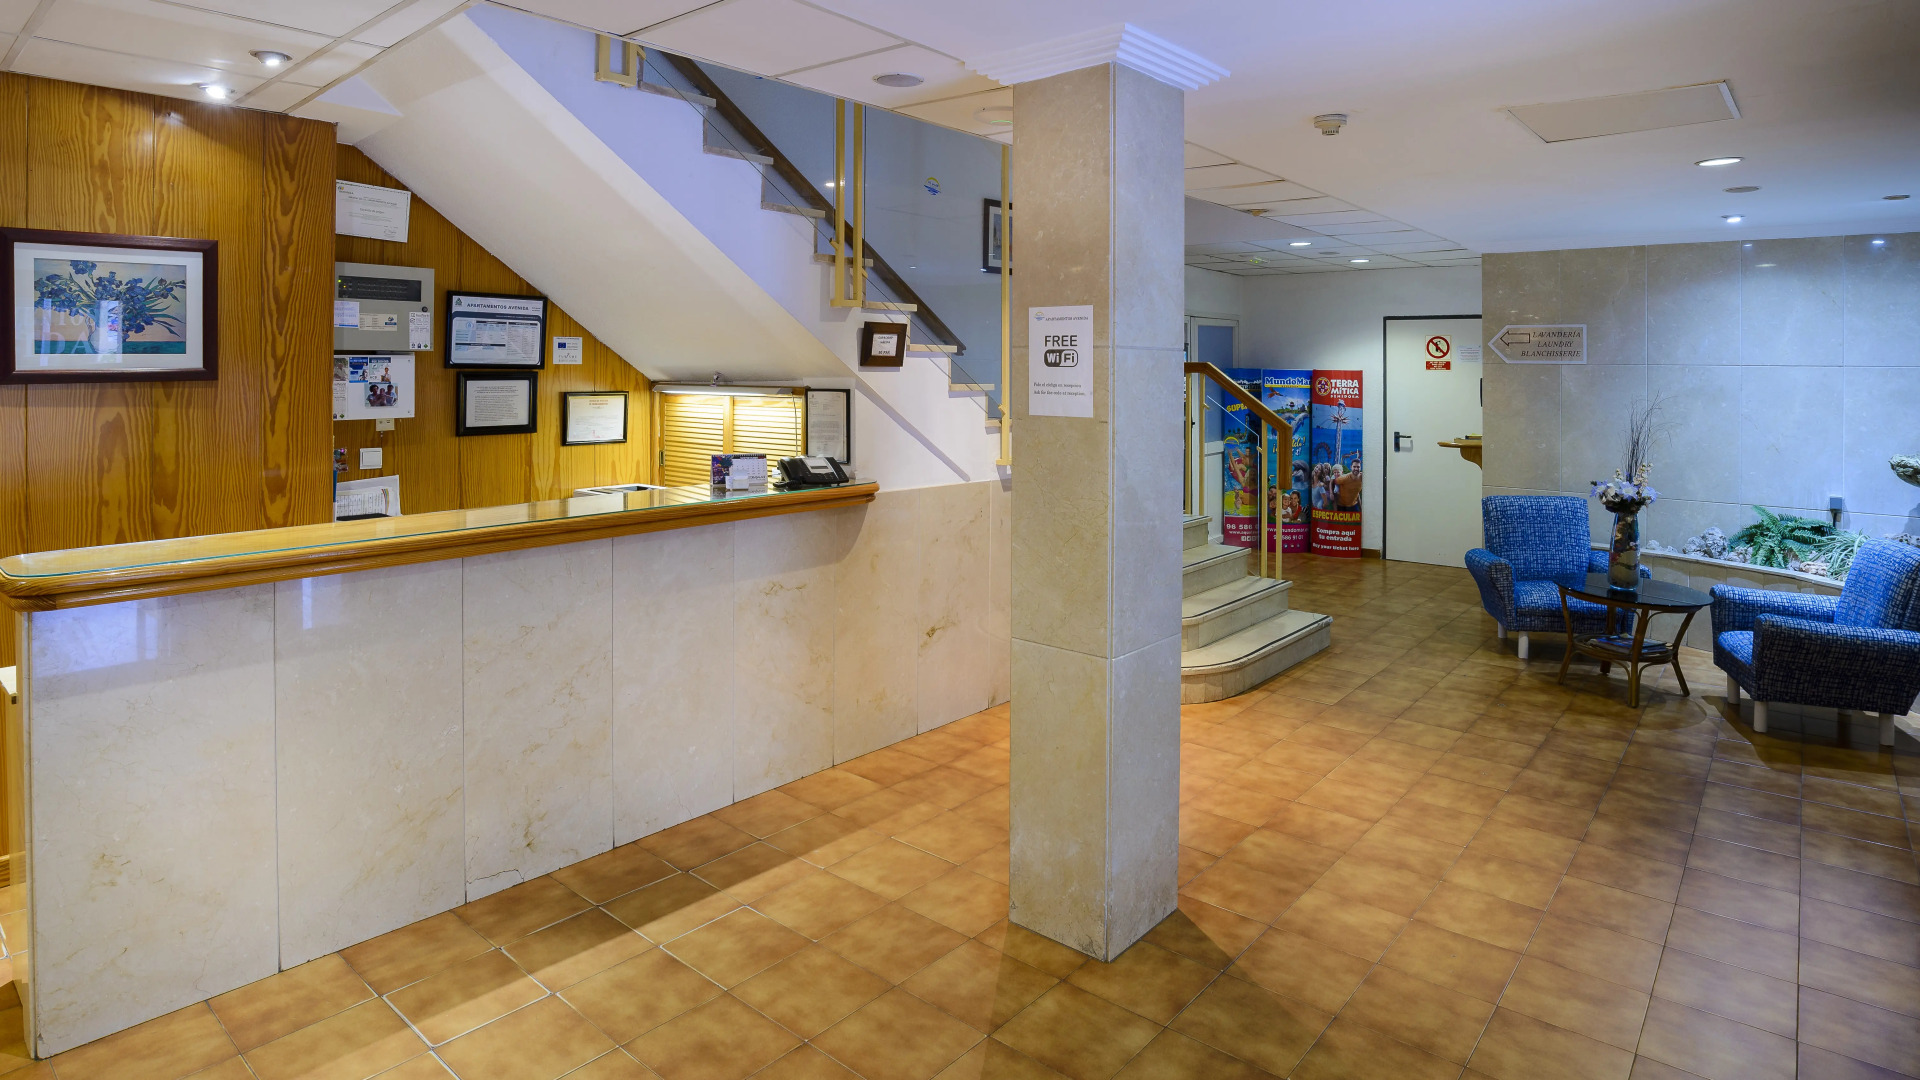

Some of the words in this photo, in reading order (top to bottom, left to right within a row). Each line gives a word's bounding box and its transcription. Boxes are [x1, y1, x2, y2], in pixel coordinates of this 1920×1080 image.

[1532, 330, 1581, 338] LAVANDERÍA
[1044, 334, 1078, 347] FREE
[1264, 376, 1310, 385] MundoMar
[1330, 380, 1359, 388] TERRA
[1226, 403, 1248, 412] SUPE
[1312, 510, 1360, 521] ESPECTACULAR
